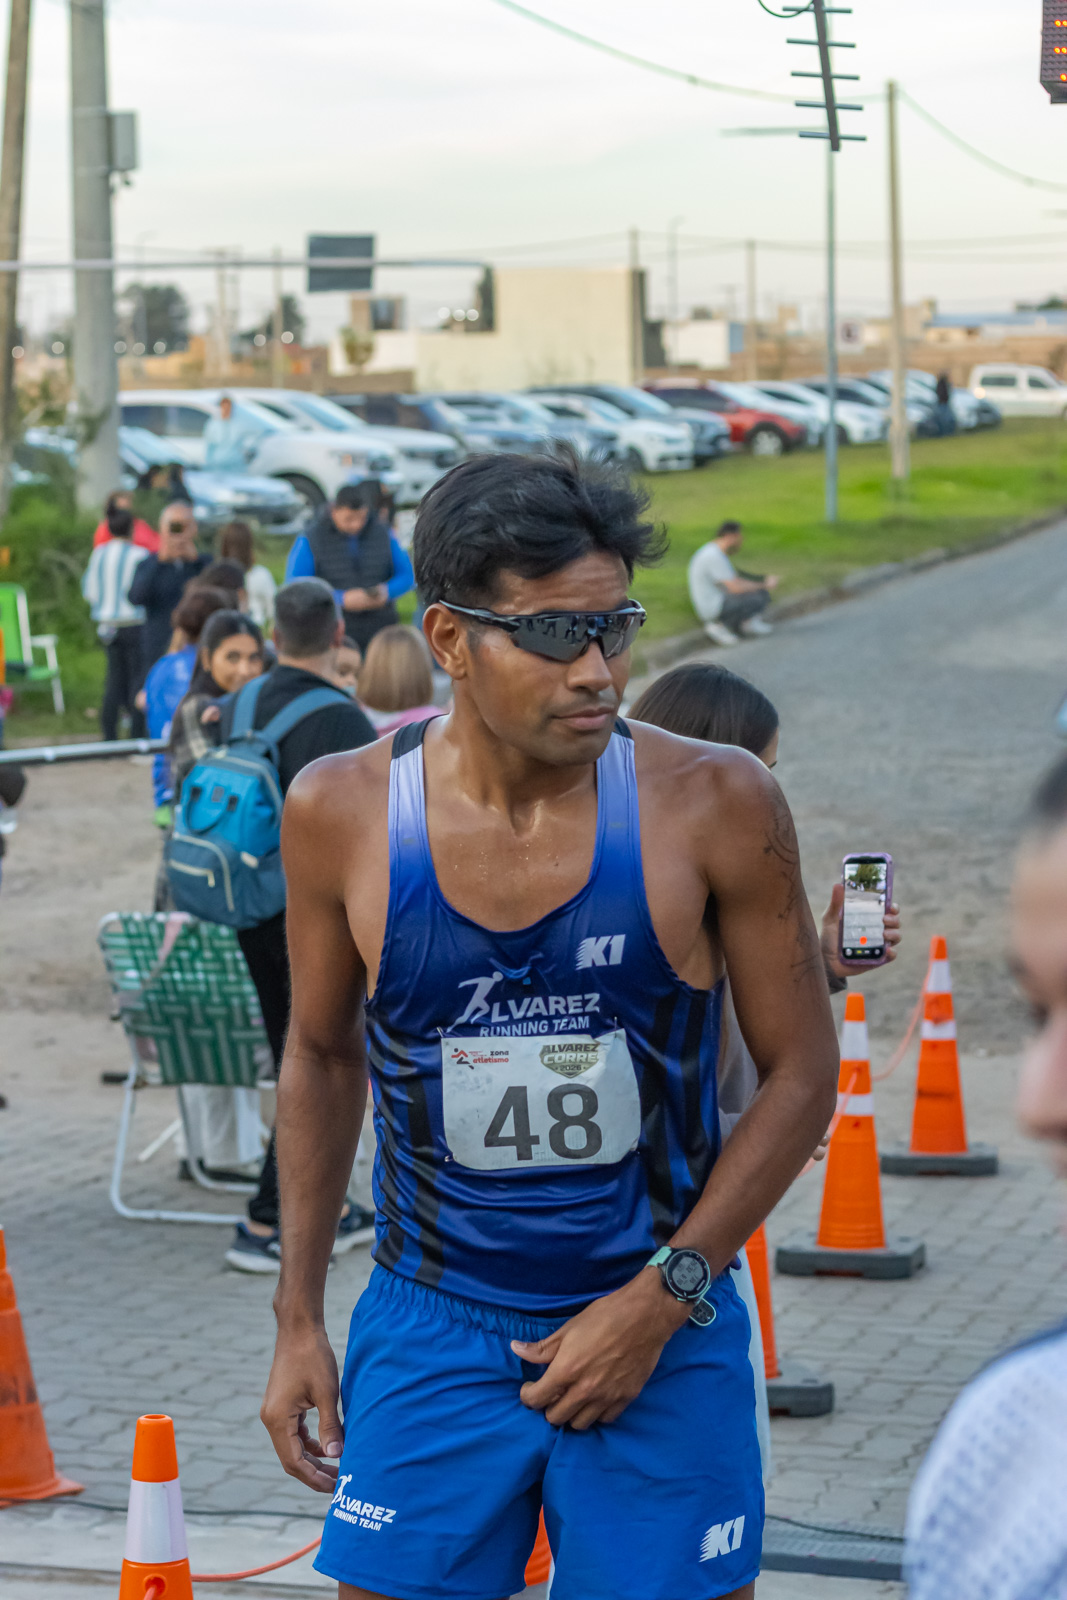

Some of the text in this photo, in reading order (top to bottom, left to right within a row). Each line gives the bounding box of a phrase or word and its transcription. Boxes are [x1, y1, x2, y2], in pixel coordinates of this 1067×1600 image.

[480, 1015, 590, 1038] RUNNING TEAM
[541, 1043, 599, 1054] ALVAREZ
[473, 1056, 509, 1064] atletismo
[543, 1052, 599, 1064] CORRE
[484, 1083, 602, 1160] 48
[359, 1517, 382, 1531] TEAM
